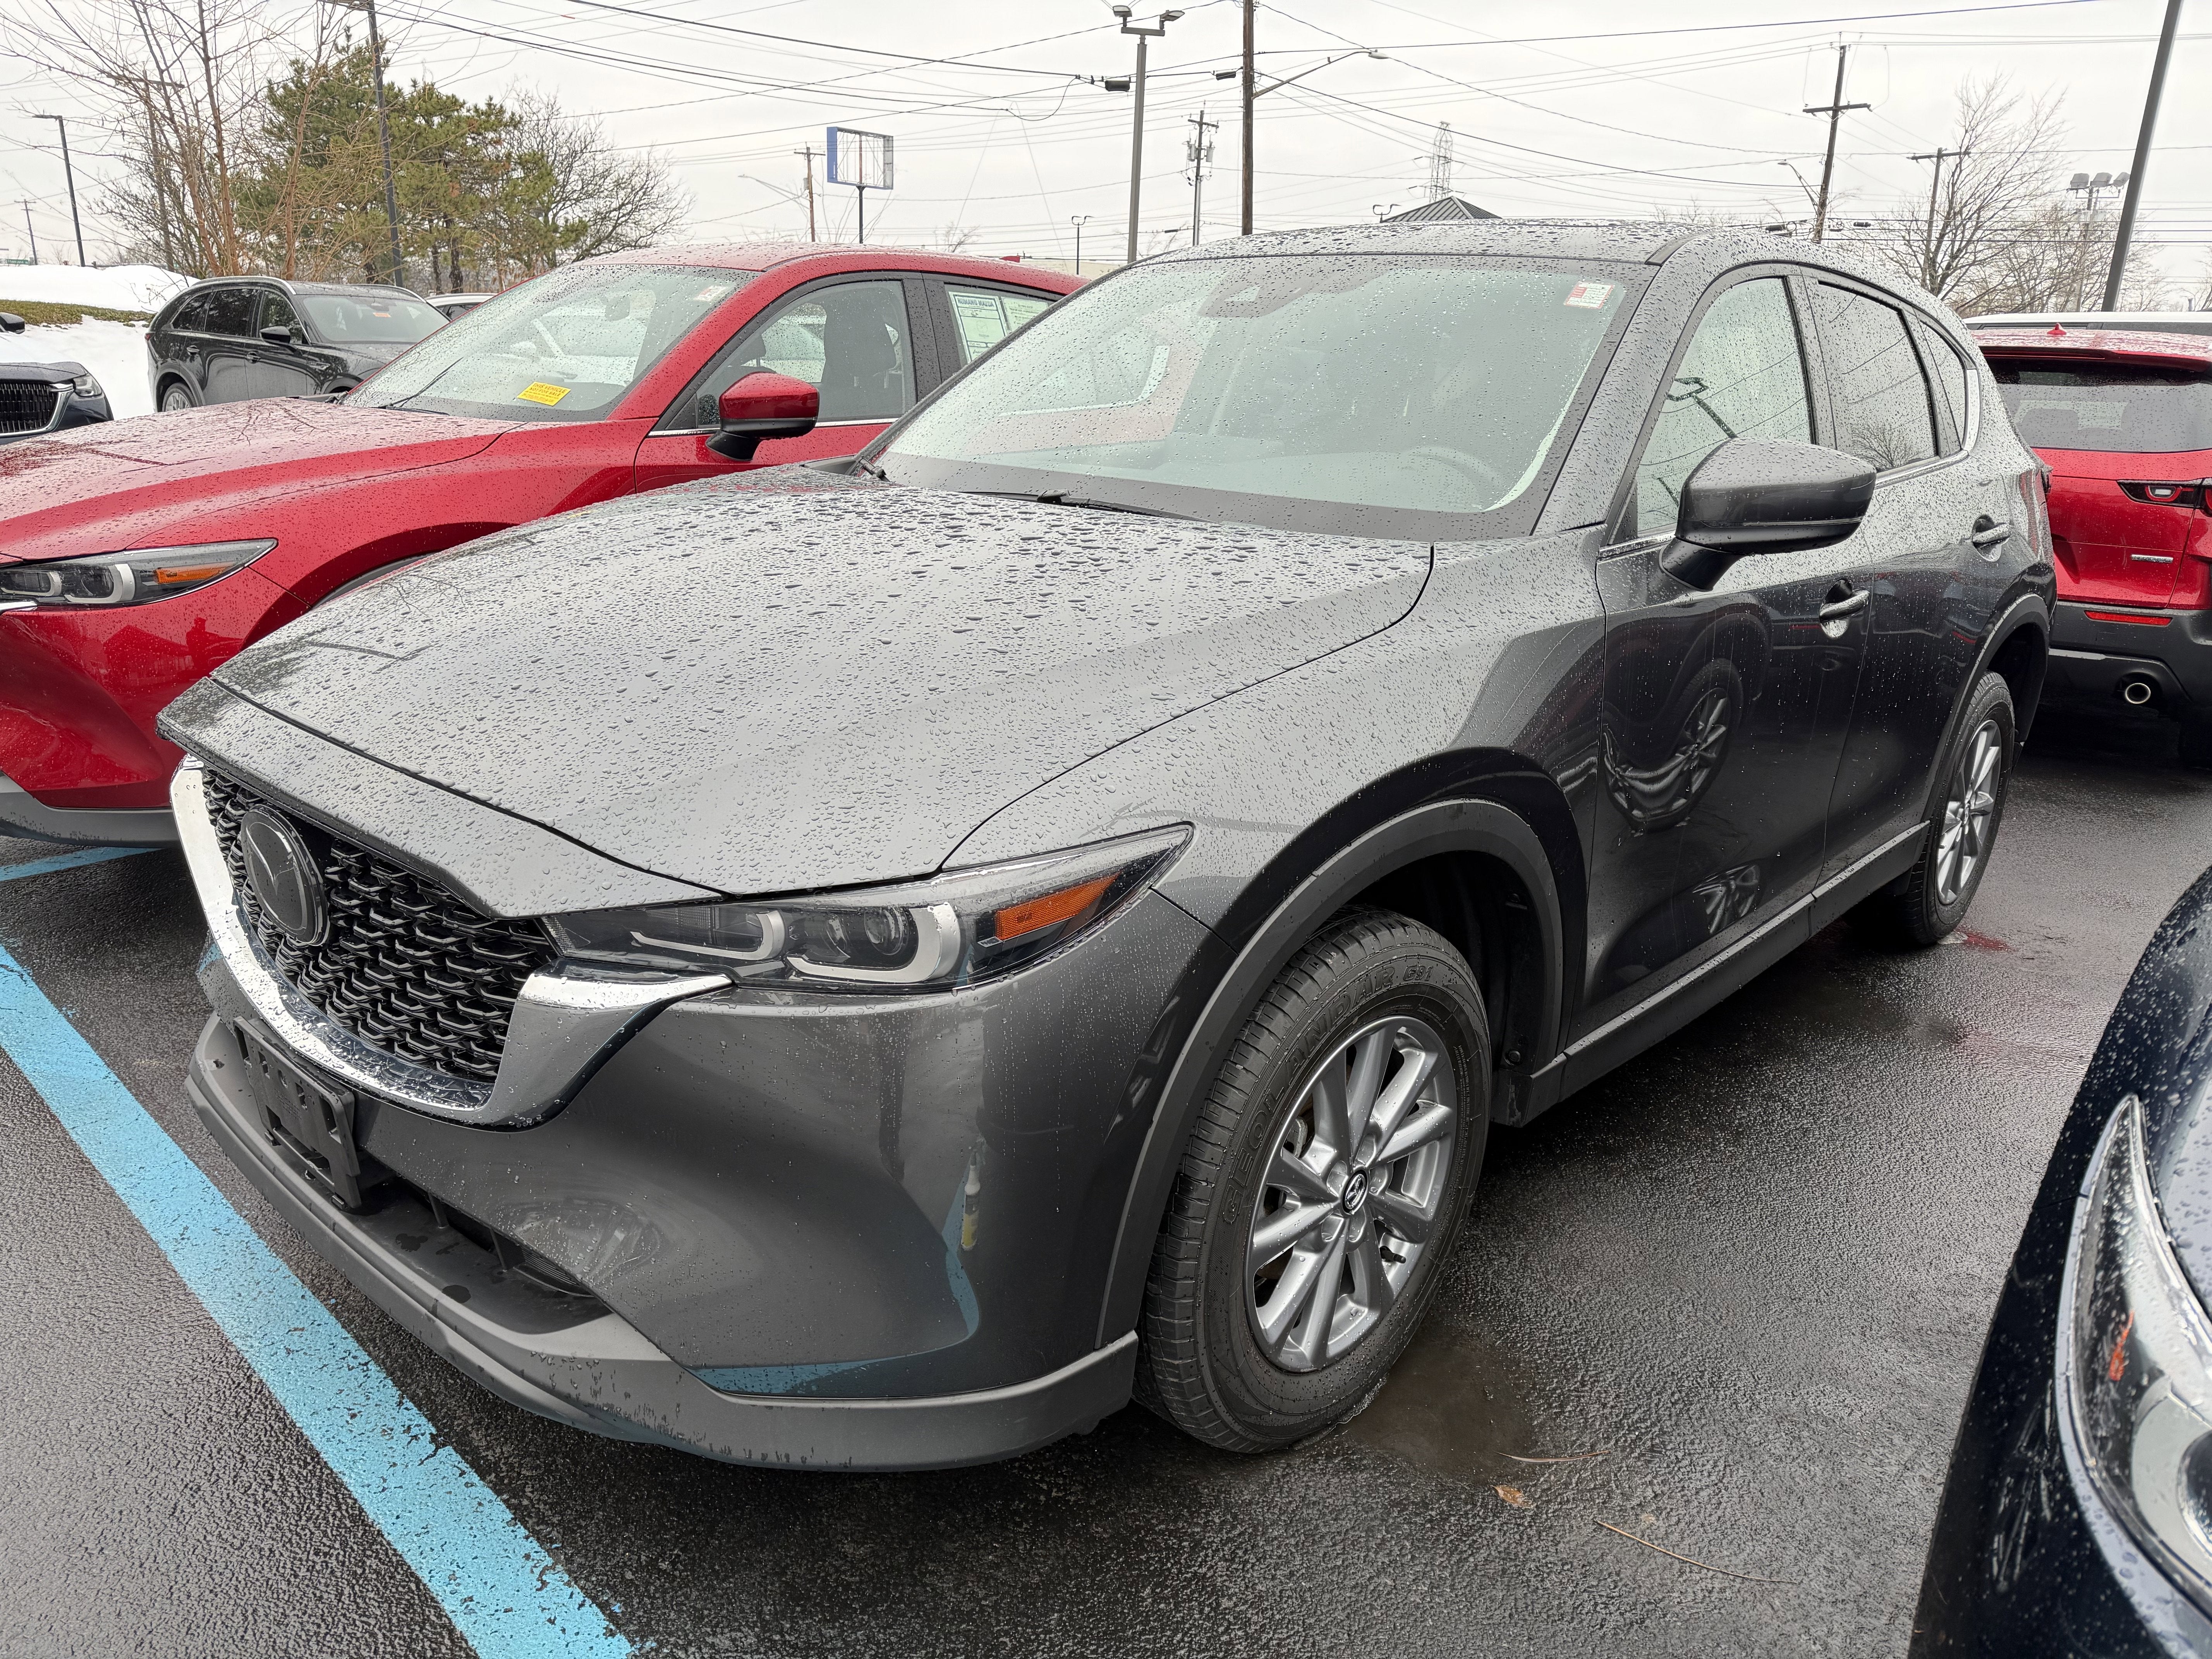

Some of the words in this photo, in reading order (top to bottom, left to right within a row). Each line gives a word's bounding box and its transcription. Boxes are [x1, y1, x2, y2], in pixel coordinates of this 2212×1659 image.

[545, 385, 567, 393] VEHICLE
[1223, 965, 1395, 1224] GEOLANDAR
[1403, 963, 1434, 982] G91
